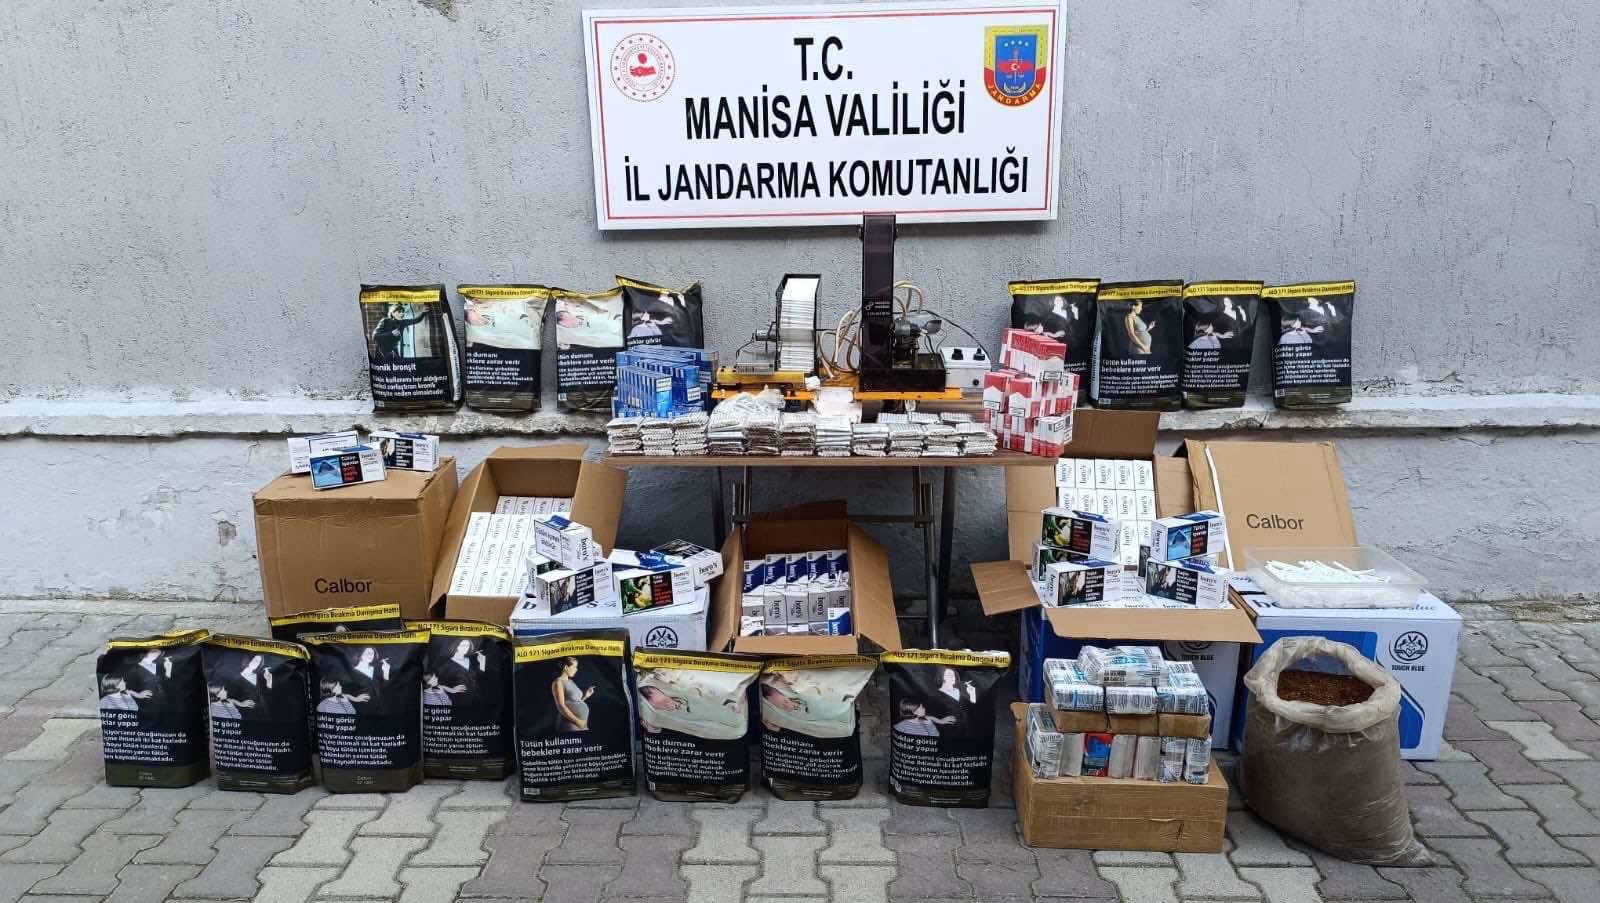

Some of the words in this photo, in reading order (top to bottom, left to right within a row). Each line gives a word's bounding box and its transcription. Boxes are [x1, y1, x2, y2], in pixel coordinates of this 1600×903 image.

[794, 36, 853, 82] T.C.
[685, 84, 817, 140] MANİSA
[826, 79, 965, 137] VALİLİĞİ
[624, 156, 650, 201] İL
[657, 161, 821, 201] JANDARMA
[829, 146, 1029, 197] KOMUTANLIĞI
[1246, 513, 1305, 530] Calbor
[314, 577, 373, 594] Calbor
[521, 747, 561, 757] bebeklere
[562, 747, 583, 755] zarar
[584, 744, 604, 752] verir
[544, 737, 583, 747] kullanımı
